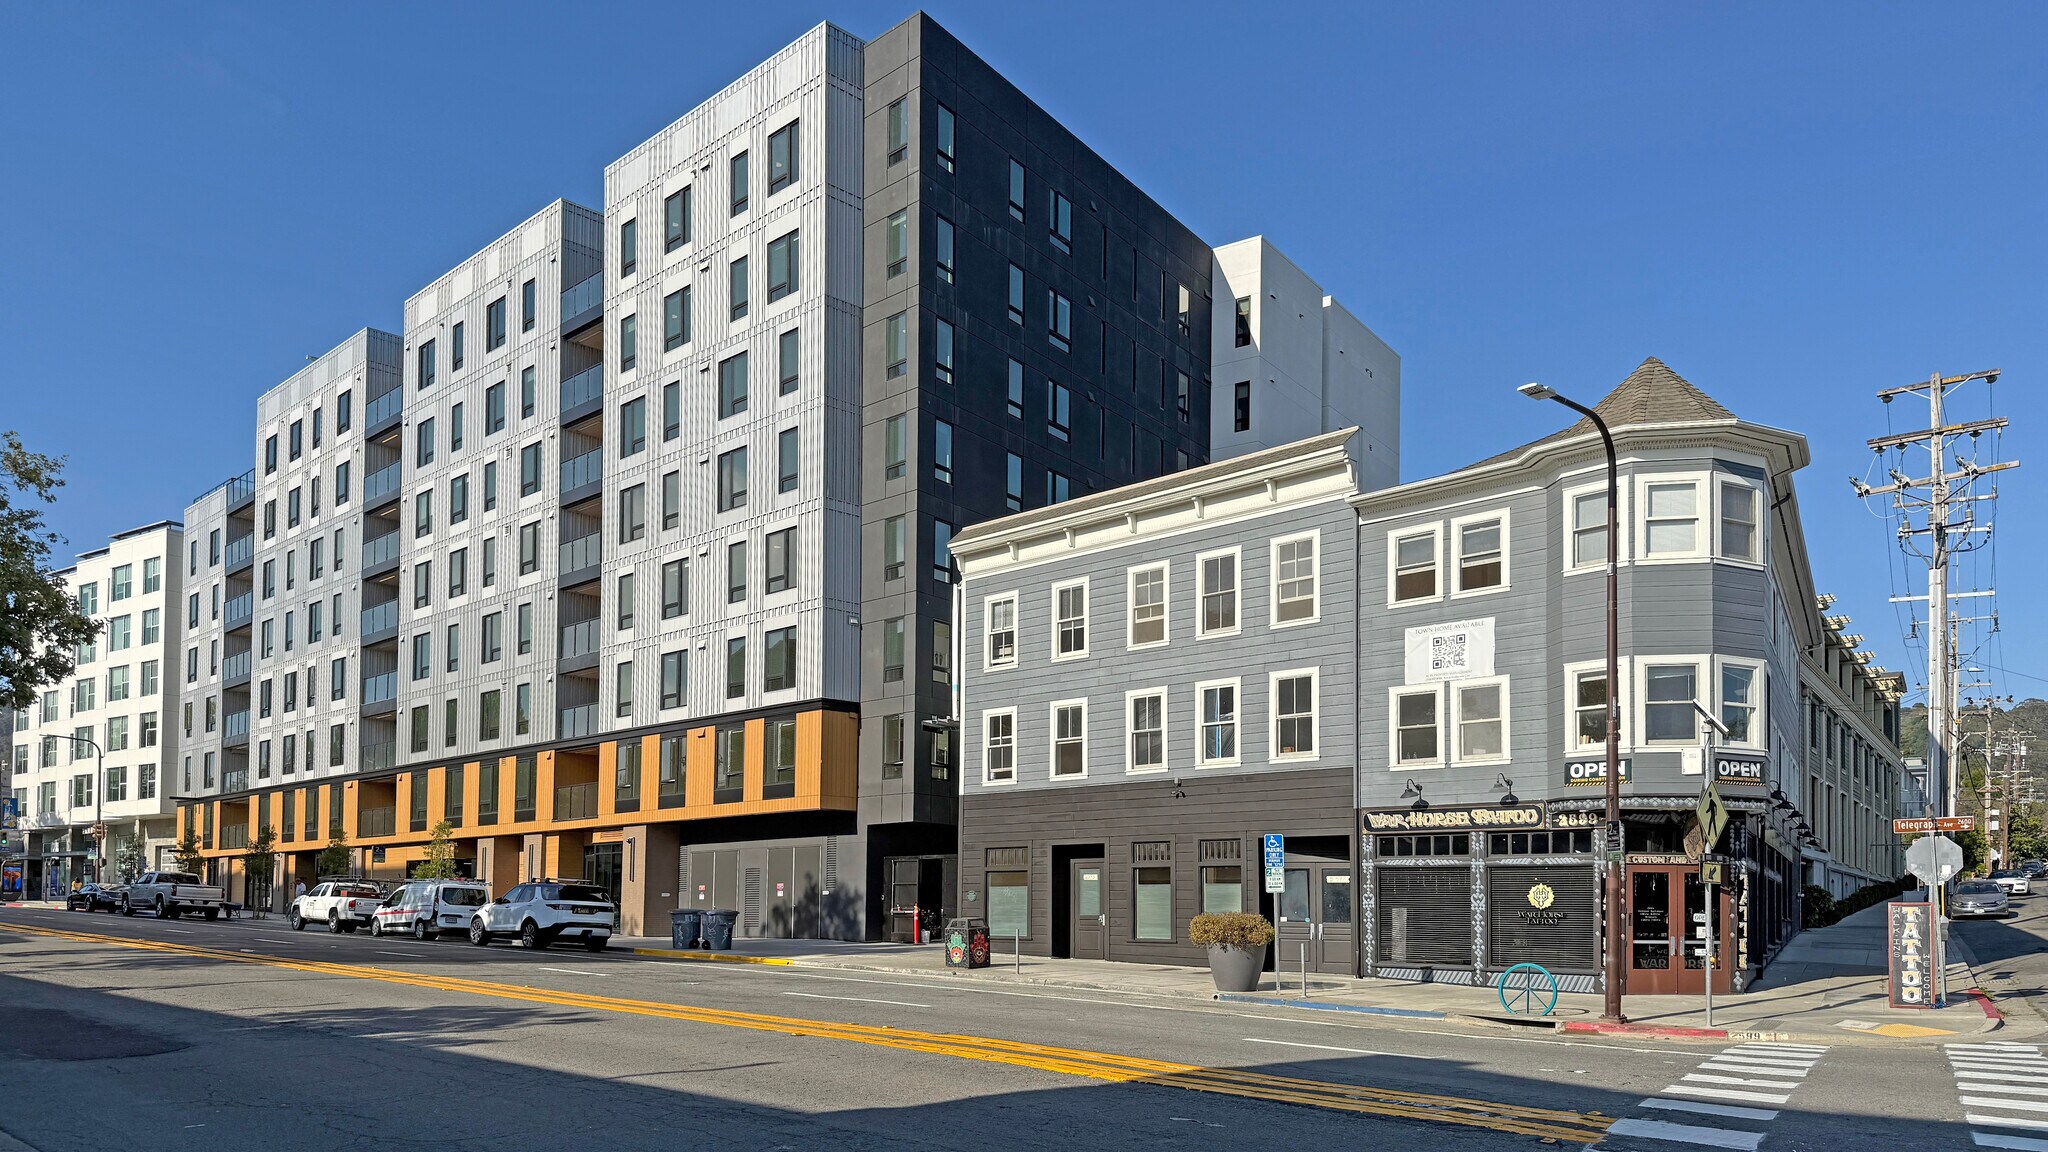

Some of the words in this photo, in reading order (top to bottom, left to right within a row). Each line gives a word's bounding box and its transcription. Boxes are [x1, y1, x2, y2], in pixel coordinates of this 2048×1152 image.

[1434, 624, 1452, 633] HOME
[1570, 761, 1626, 779] OPEN
[1718, 760, 1761, 777] OPEN
[1367, 813, 1407, 829] WAR
[1407, 811, 1471, 827] HORSE
[1471, 809, 1538, 824] TATTOO
[1897, 821, 1939, 832] Telegrap
[1632, 856, 1666, 864] CUSTOM
[1901, 906, 1922, 1003] TATTOO
[1640, 958, 1667, 969] WAR
[1923, 953, 1931, 1005] WELCOME
